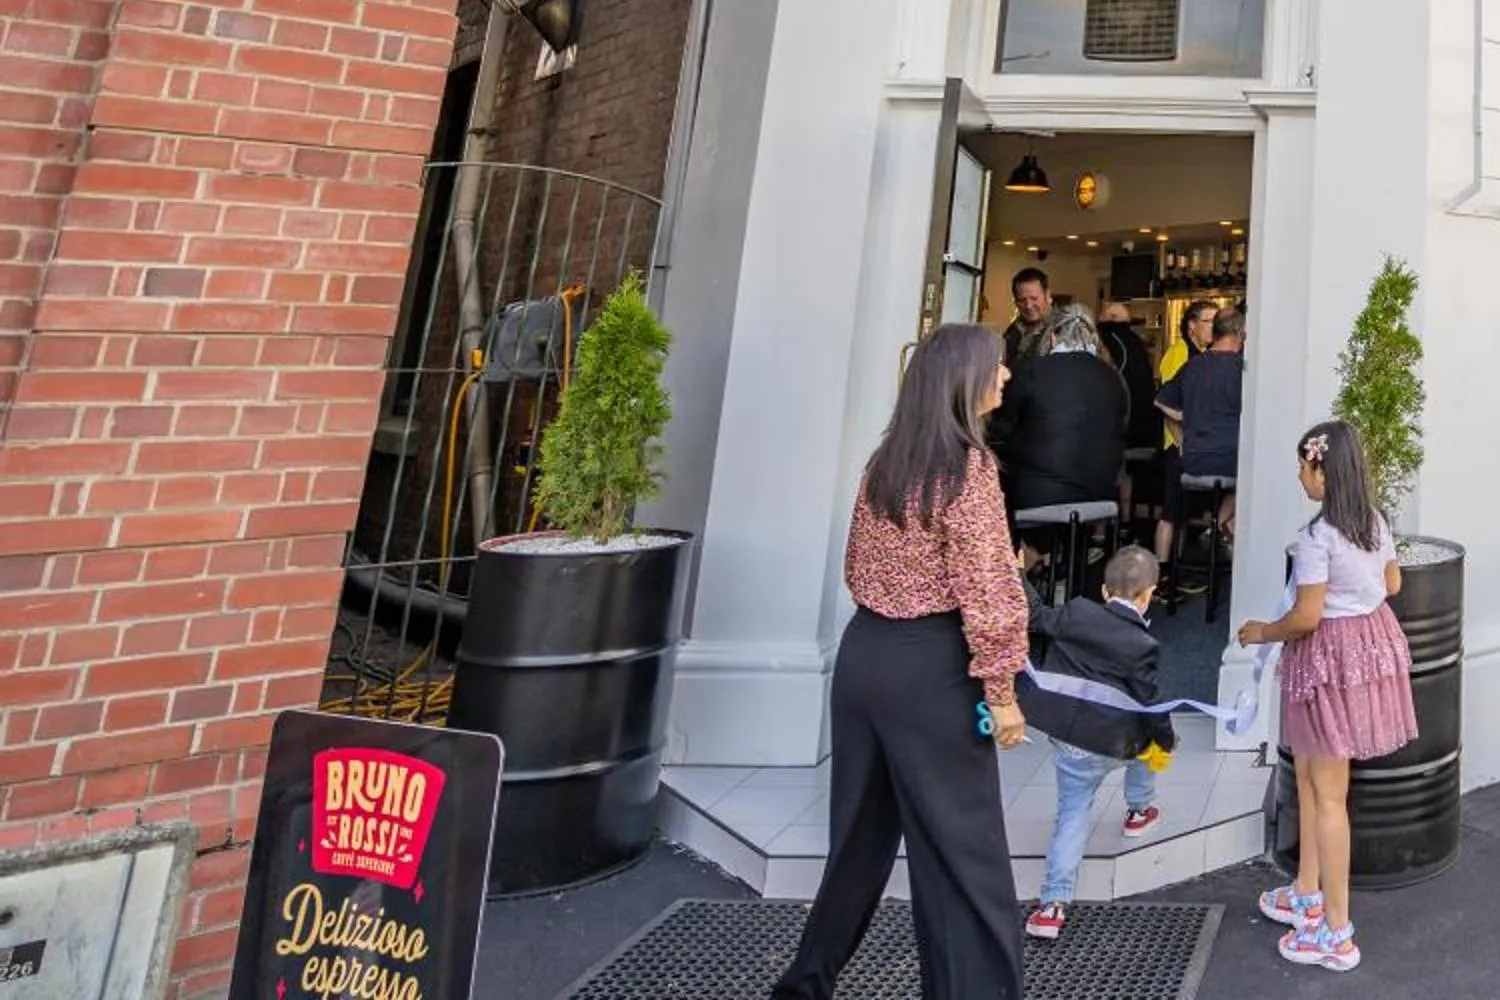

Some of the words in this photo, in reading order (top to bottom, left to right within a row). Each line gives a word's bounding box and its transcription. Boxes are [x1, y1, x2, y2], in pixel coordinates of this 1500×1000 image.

[325, 759, 427, 823] BRUNO
[337, 814, 400, 857] ROSSI
[275, 882, 429, 964] Delizioso
[301, 954, 423, 1000] espresso
